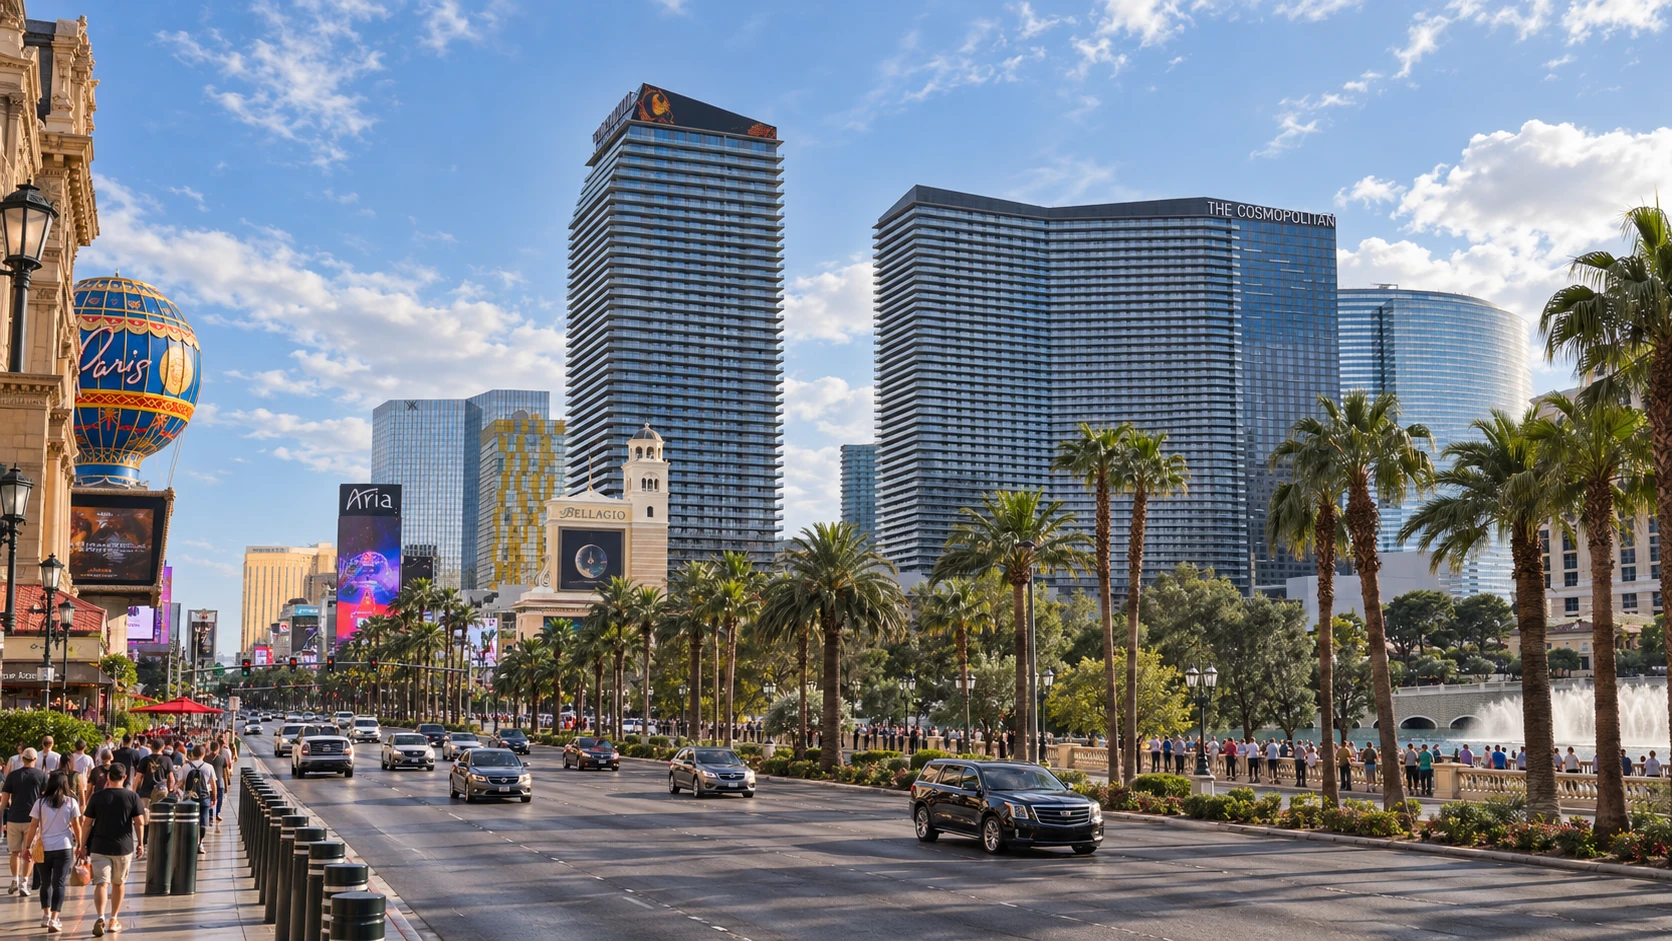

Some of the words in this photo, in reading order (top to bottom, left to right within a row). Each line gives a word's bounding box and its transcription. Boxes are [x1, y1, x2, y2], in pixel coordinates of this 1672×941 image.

[1207, 201, 1232, 217] THE
[1237, 204, 1335, 227] COSMOPOLITAN
[78, 326, 152, 396] Paris
[346, 488, 393, 510] Aria
[559, 507, 626, 520] BELLAGIO
